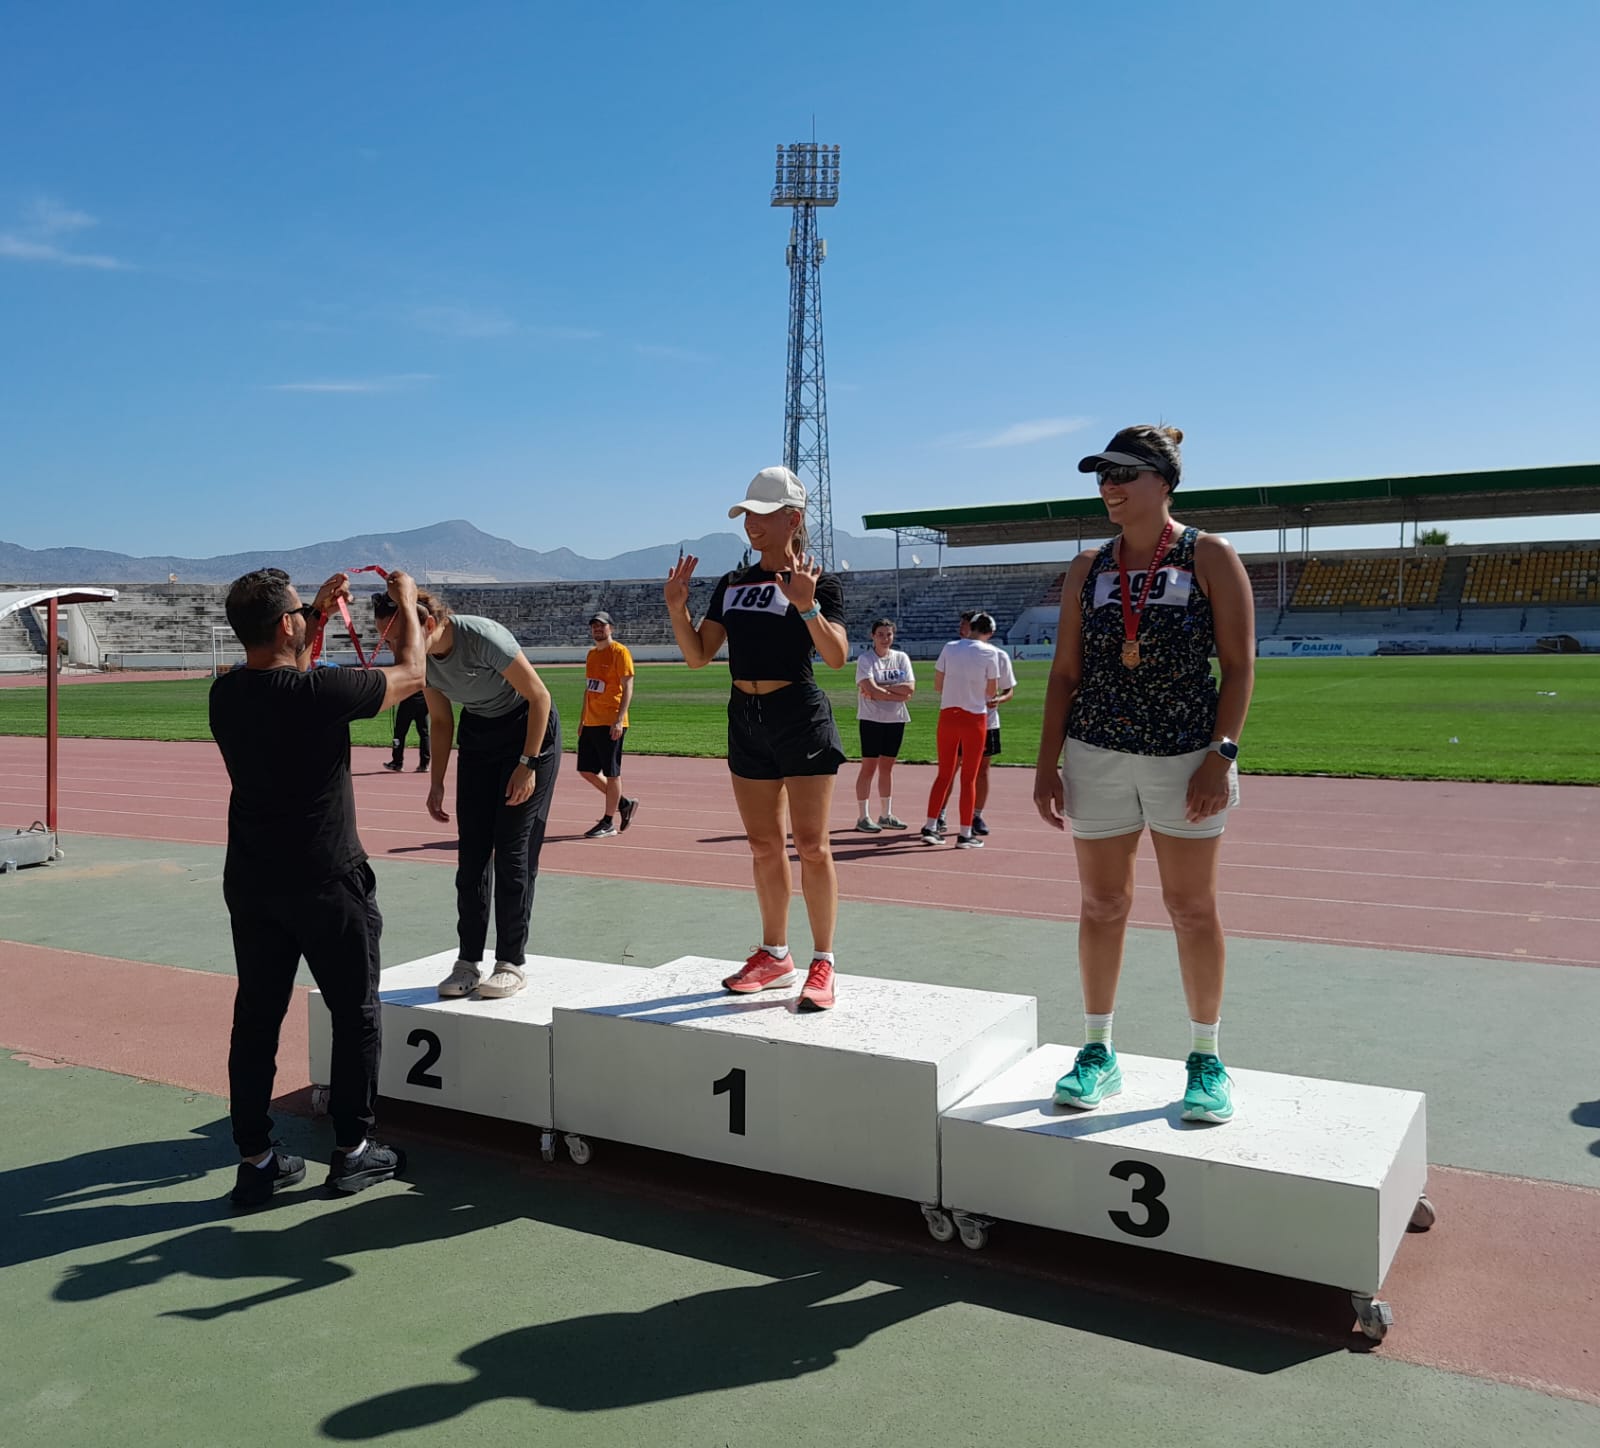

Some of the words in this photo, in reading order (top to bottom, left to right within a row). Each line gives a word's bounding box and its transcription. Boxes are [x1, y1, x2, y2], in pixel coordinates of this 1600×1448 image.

[731, 585, 776, 609] 189
[1302, 643, 1343, 652] DAIKIN
[406, 1028, 443, 1090] 2
[713, 1067, 746, 1137] 1
[1107, 1160, 1170, 1238] 3
